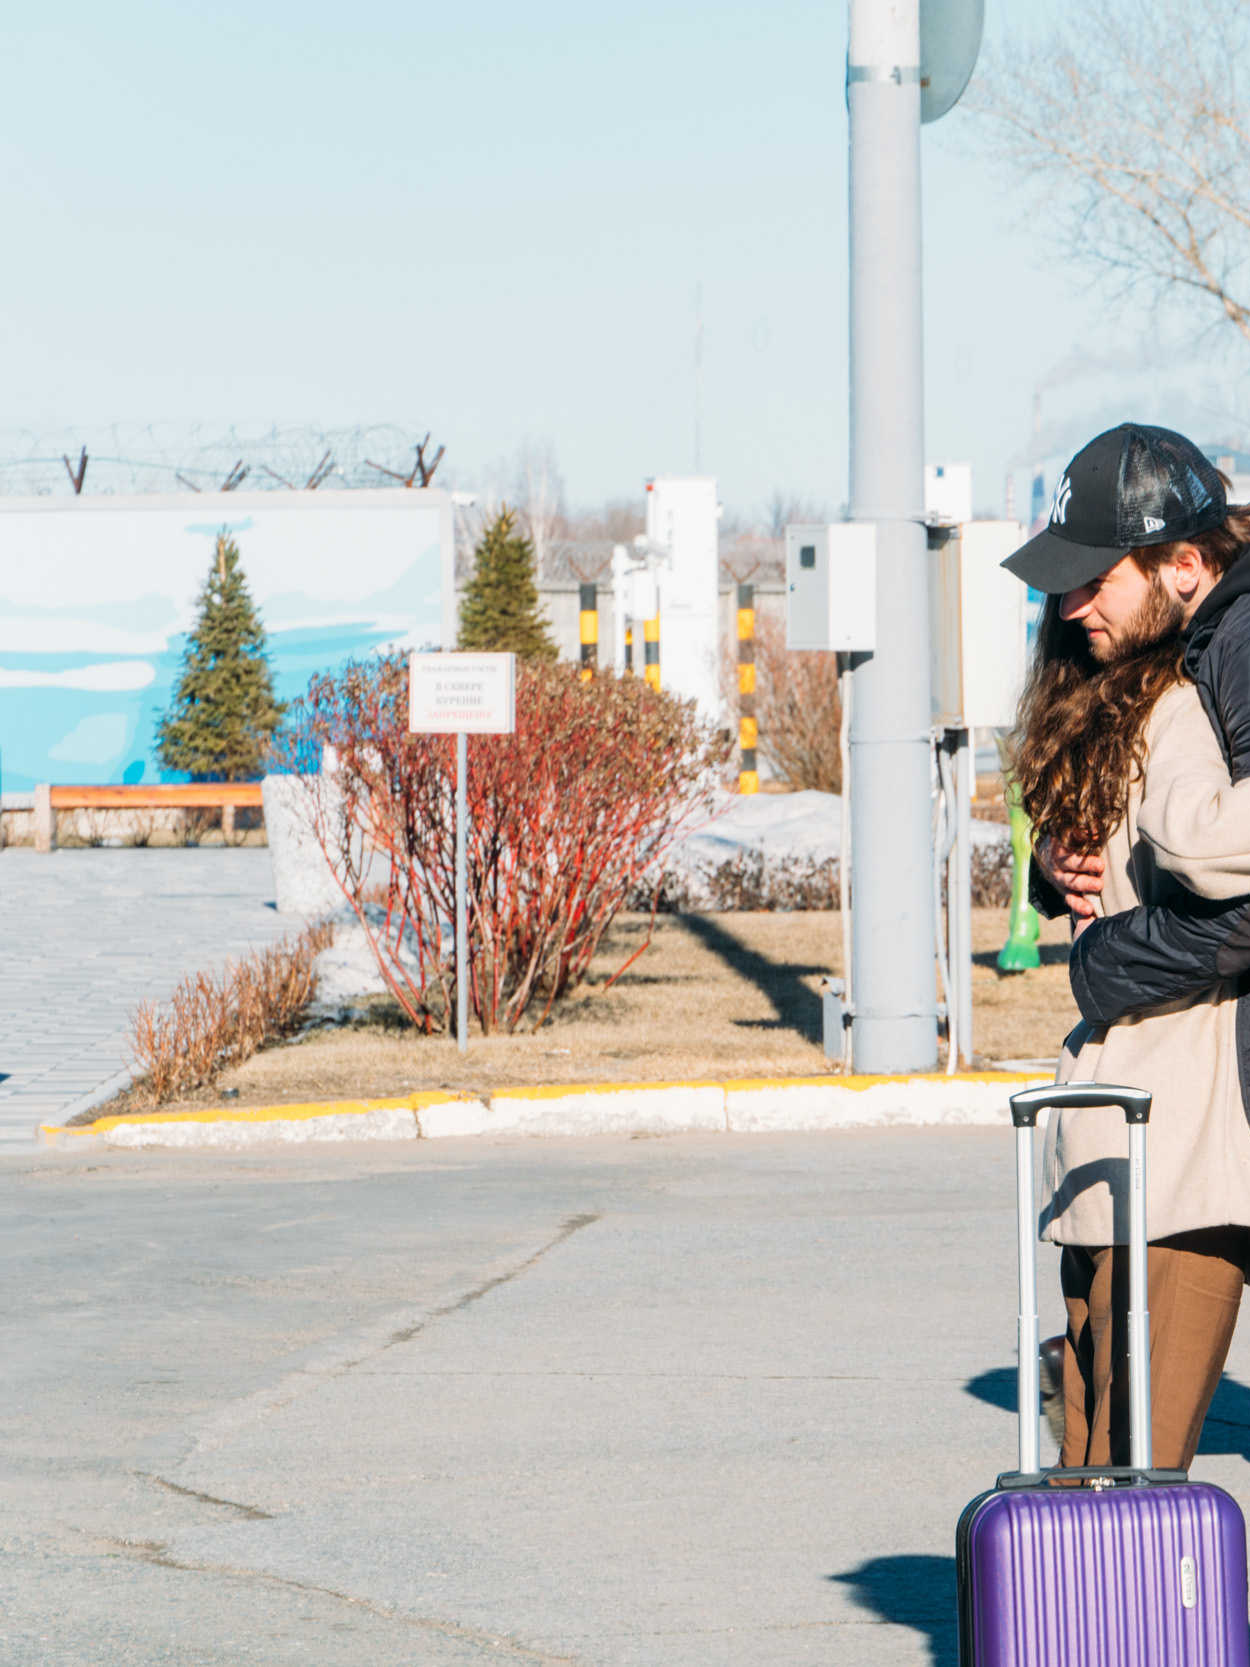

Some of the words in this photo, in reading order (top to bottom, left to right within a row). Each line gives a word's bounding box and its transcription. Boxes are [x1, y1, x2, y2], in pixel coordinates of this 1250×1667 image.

[435, 682, 442, 691] В
[444, 682, 484, 691] СКВЕРЕ
[435, 696, 484, 705] КУРЕНИЕ
